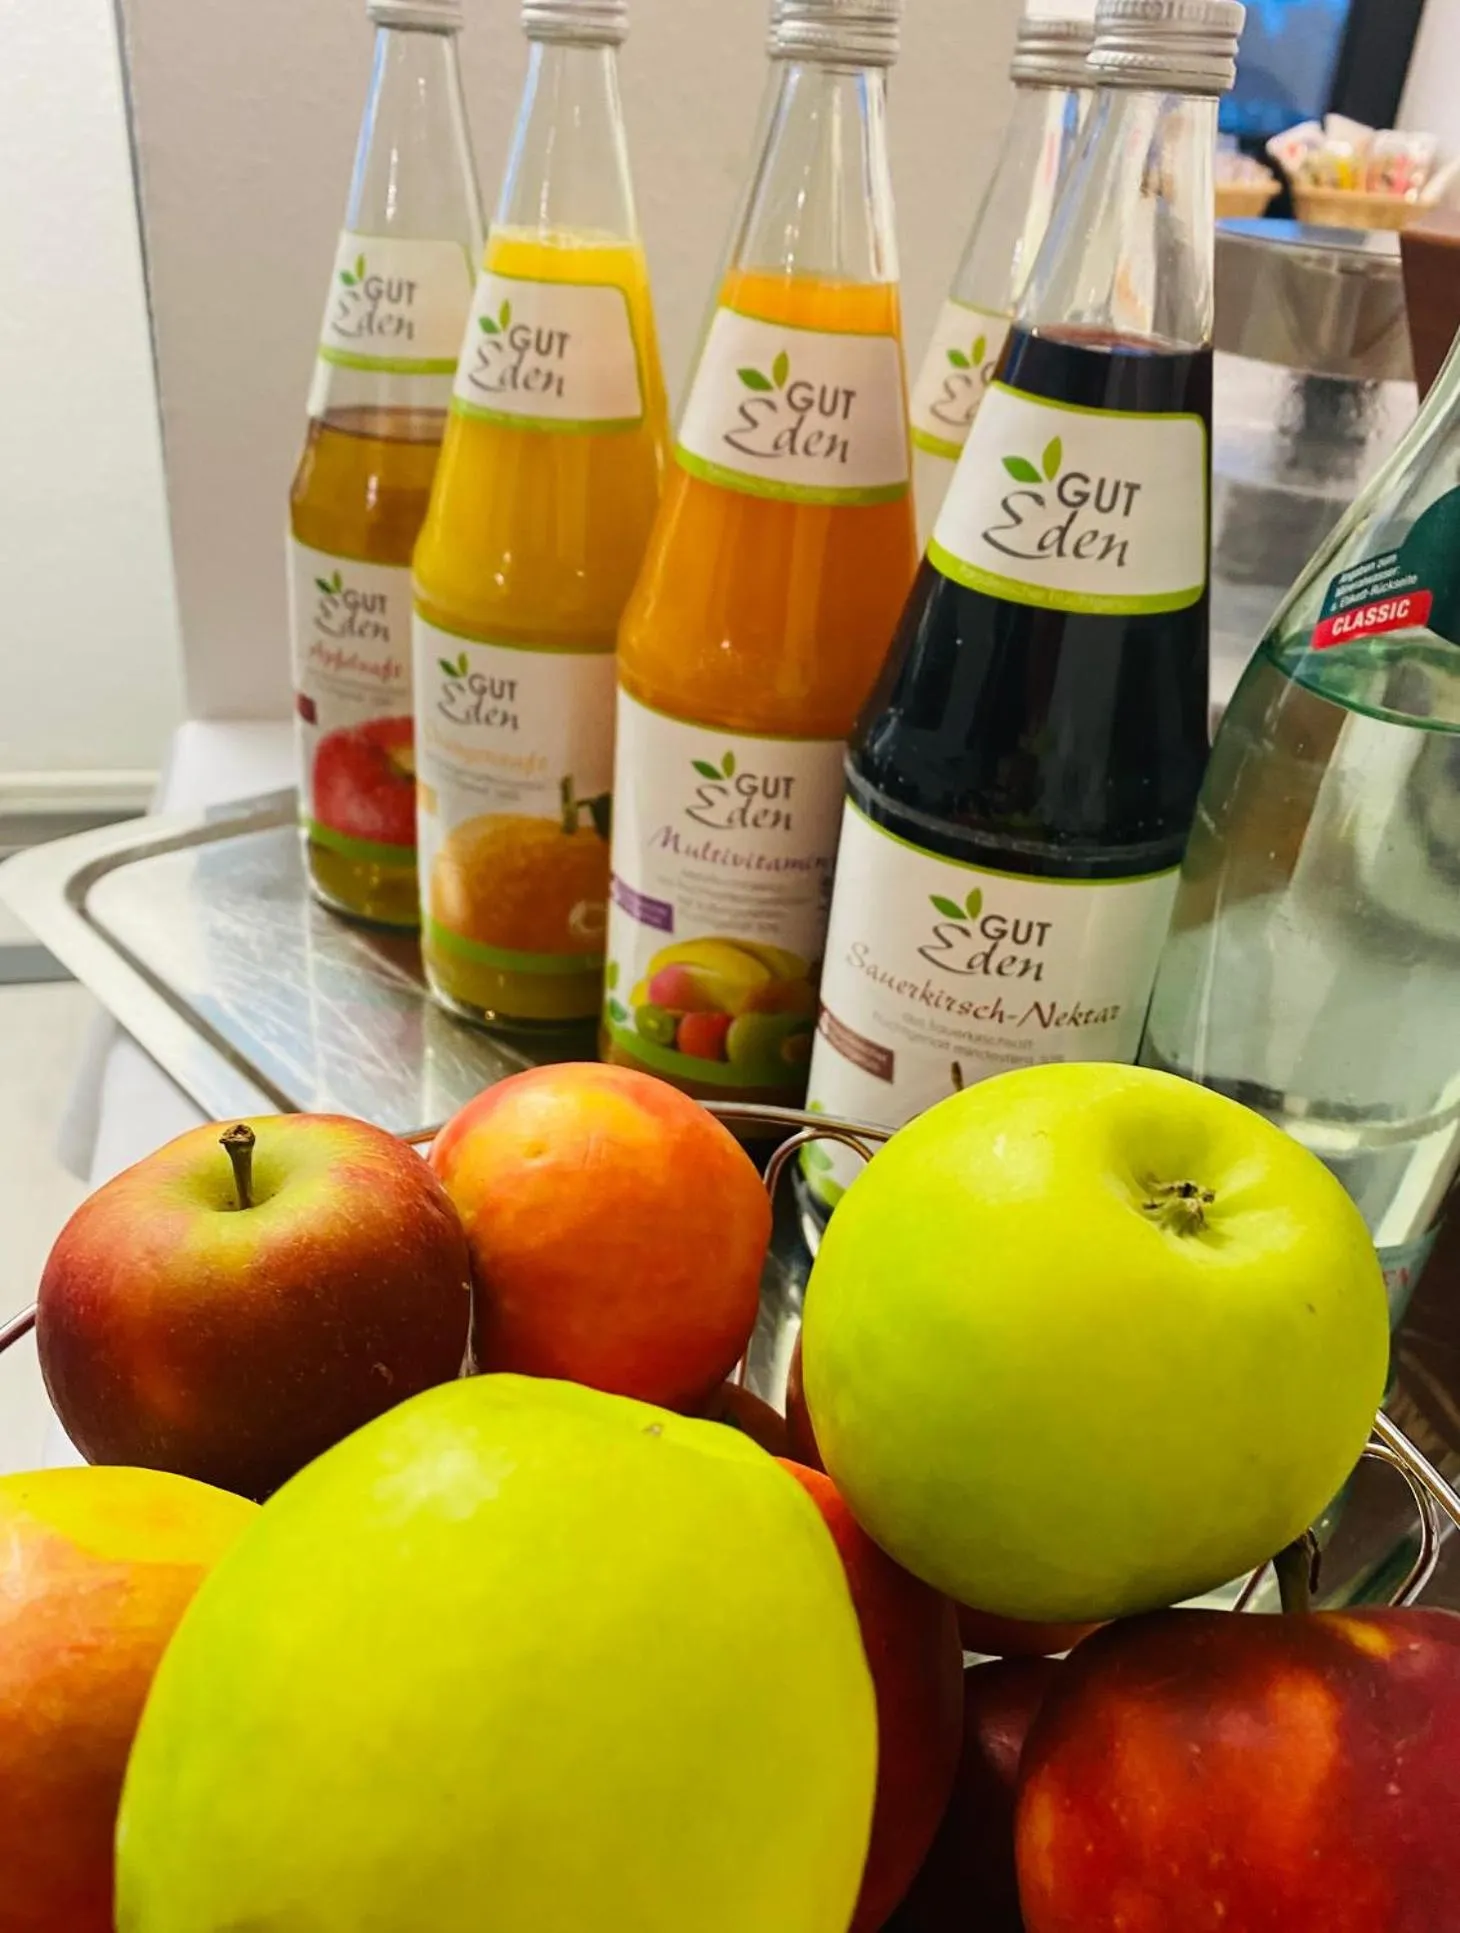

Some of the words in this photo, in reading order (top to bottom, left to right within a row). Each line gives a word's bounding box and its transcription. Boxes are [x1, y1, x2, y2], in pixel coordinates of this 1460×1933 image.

[364, 276, 417, 305] GUT
[331, 290, 414, 340] Eden
[509, 324, 570, 359] GUT
[468, 340, 565, 397] Eden
[786, 380, 856, 420] GUT
[722, 397, 849, 463] Eden
[1057, 471, 1141, 516] GUT
[981, 490, 1130, 567] Eden
[314, 596, 390, 642] Eden
[341, 589, 388, 614] GUT
[1331, 599, 1410, 637] CLASSIC
[437, 681, 520, 731] Eden
[468, 673, 518, 702] GUT
[685, 783, 792, 831] Eden
[735, 773, 795, 800] GUT
[917, 923, 1043, 982] Eden
[980, 914, 1052, 947] GUT
[846, 940, 1121, 1029] Sauerkirsch-Nektar
